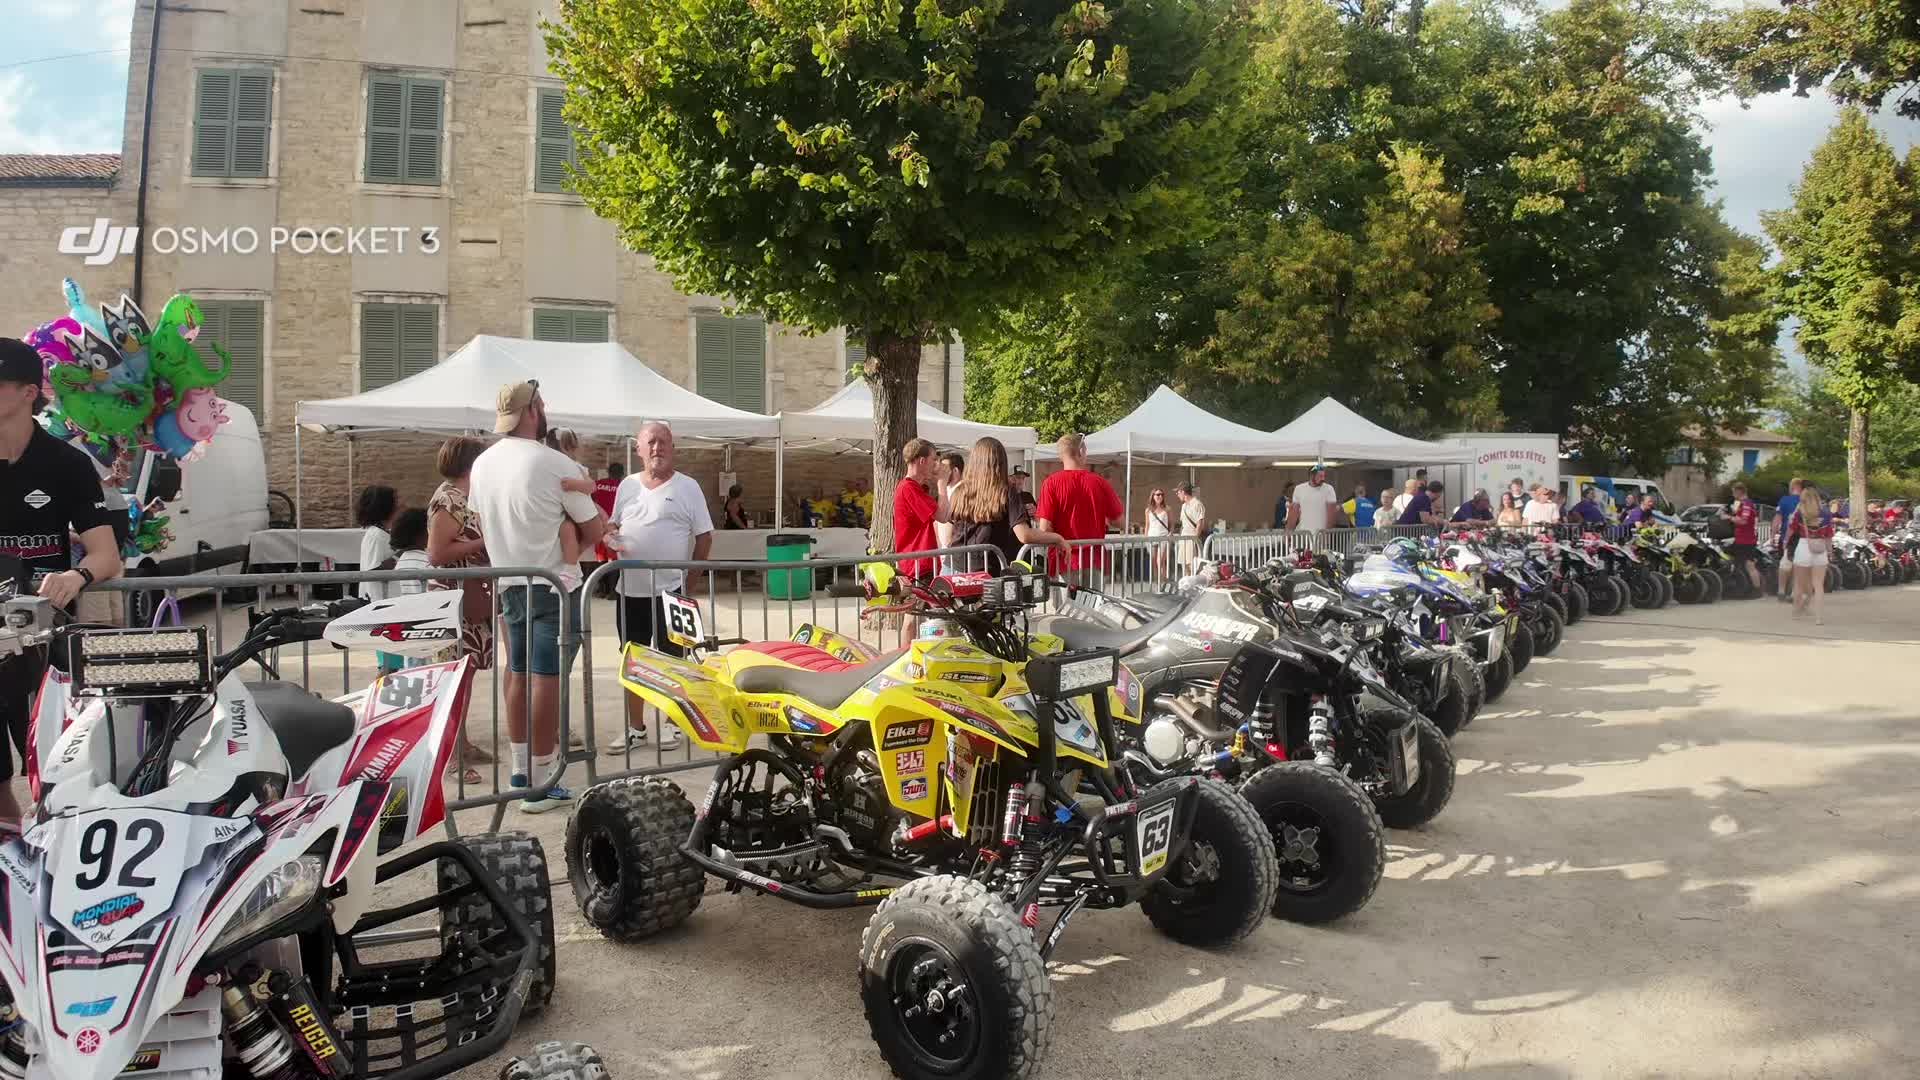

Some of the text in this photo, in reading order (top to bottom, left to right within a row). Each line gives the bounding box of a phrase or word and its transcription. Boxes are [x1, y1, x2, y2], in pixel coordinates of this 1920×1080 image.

[669, 603, 697, 638] 63
[912, 686, 963, 702] SUZUKI
[231, 700, 248, 739] YUASA
[886, 726, 917, 739] Elka
[62, 727, 89, 764] UASA
[357, 738, 406, 781] YAMAHA
[213, 823, 237, 840] AIN
[1142, 815, 1170, 857] 63
[75, 818, 165, 891] 92
[73, 893, 140, 926] MONDIAL
[81, 918, 98, 929] DU
[289, 1004, 337, 1059] REIGER
